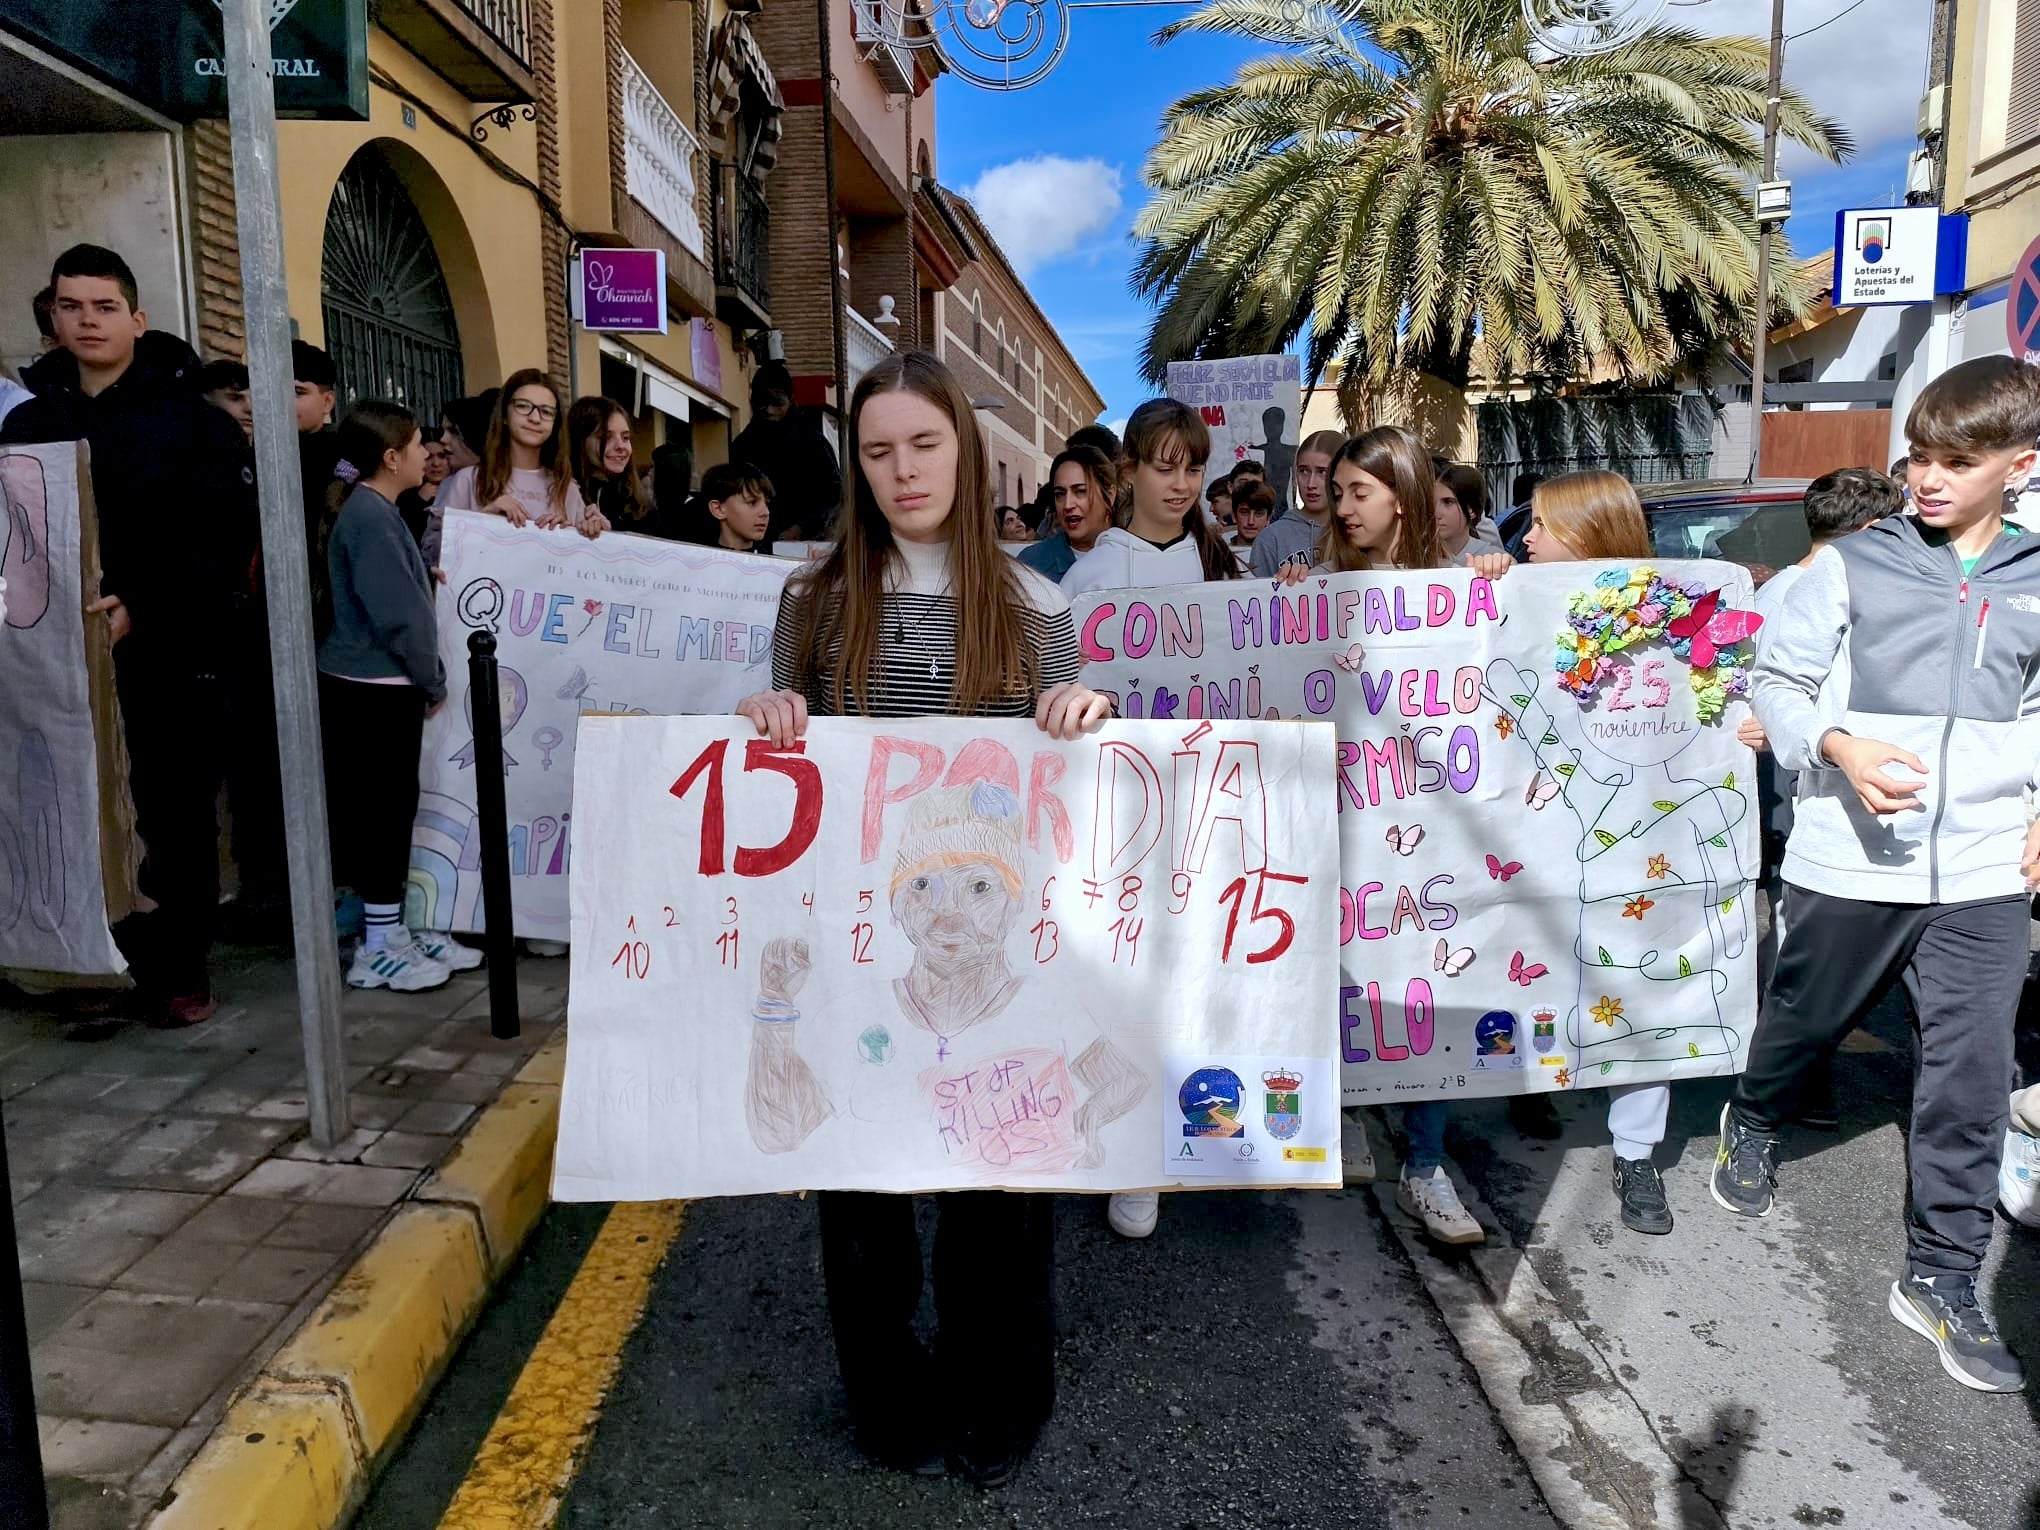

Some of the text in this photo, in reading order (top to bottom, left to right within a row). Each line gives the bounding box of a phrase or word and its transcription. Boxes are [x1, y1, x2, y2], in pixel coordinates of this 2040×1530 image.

[1853, 287, 1886, 296] Estado
[1854, 265, 1900, 276] Loterías y
[1854, 275, 1914, 288] Apuestas del
[1168, 363, 1216, 384] FELIZ
[1263, 359, 1283, 381] EL
[1168, 383, 1204, 404] QUE
[1206, 383, 1229, 402] NO
[457, 577, 574, 643] QUE
[604, 602, 660, 658] EL
[1080, 601, 1204, 662] CON
[1304, 669, 1336, 715] O
[1361, 665, 1484, 717] VELO
[1606, 660, 1671, 713] 25
[1590, 711, 1692, 739] noviembre
[1337, 724, 1480, 813] RMISO
[669, 720, 1267, 886] 15 POR DÍA
[611, 870, 1309, 980] 10 11 12 13 14 15
[627, 872, 1192, 935] 1 2 3 4 5 6 7 8 9
[1340, 873, 1459, 946] OCAS
[934, 1060, 1025, 1109] STOP
[938, 1075, 1063, 1154] KILLING
[978, 1118, 1049, 1166] US
